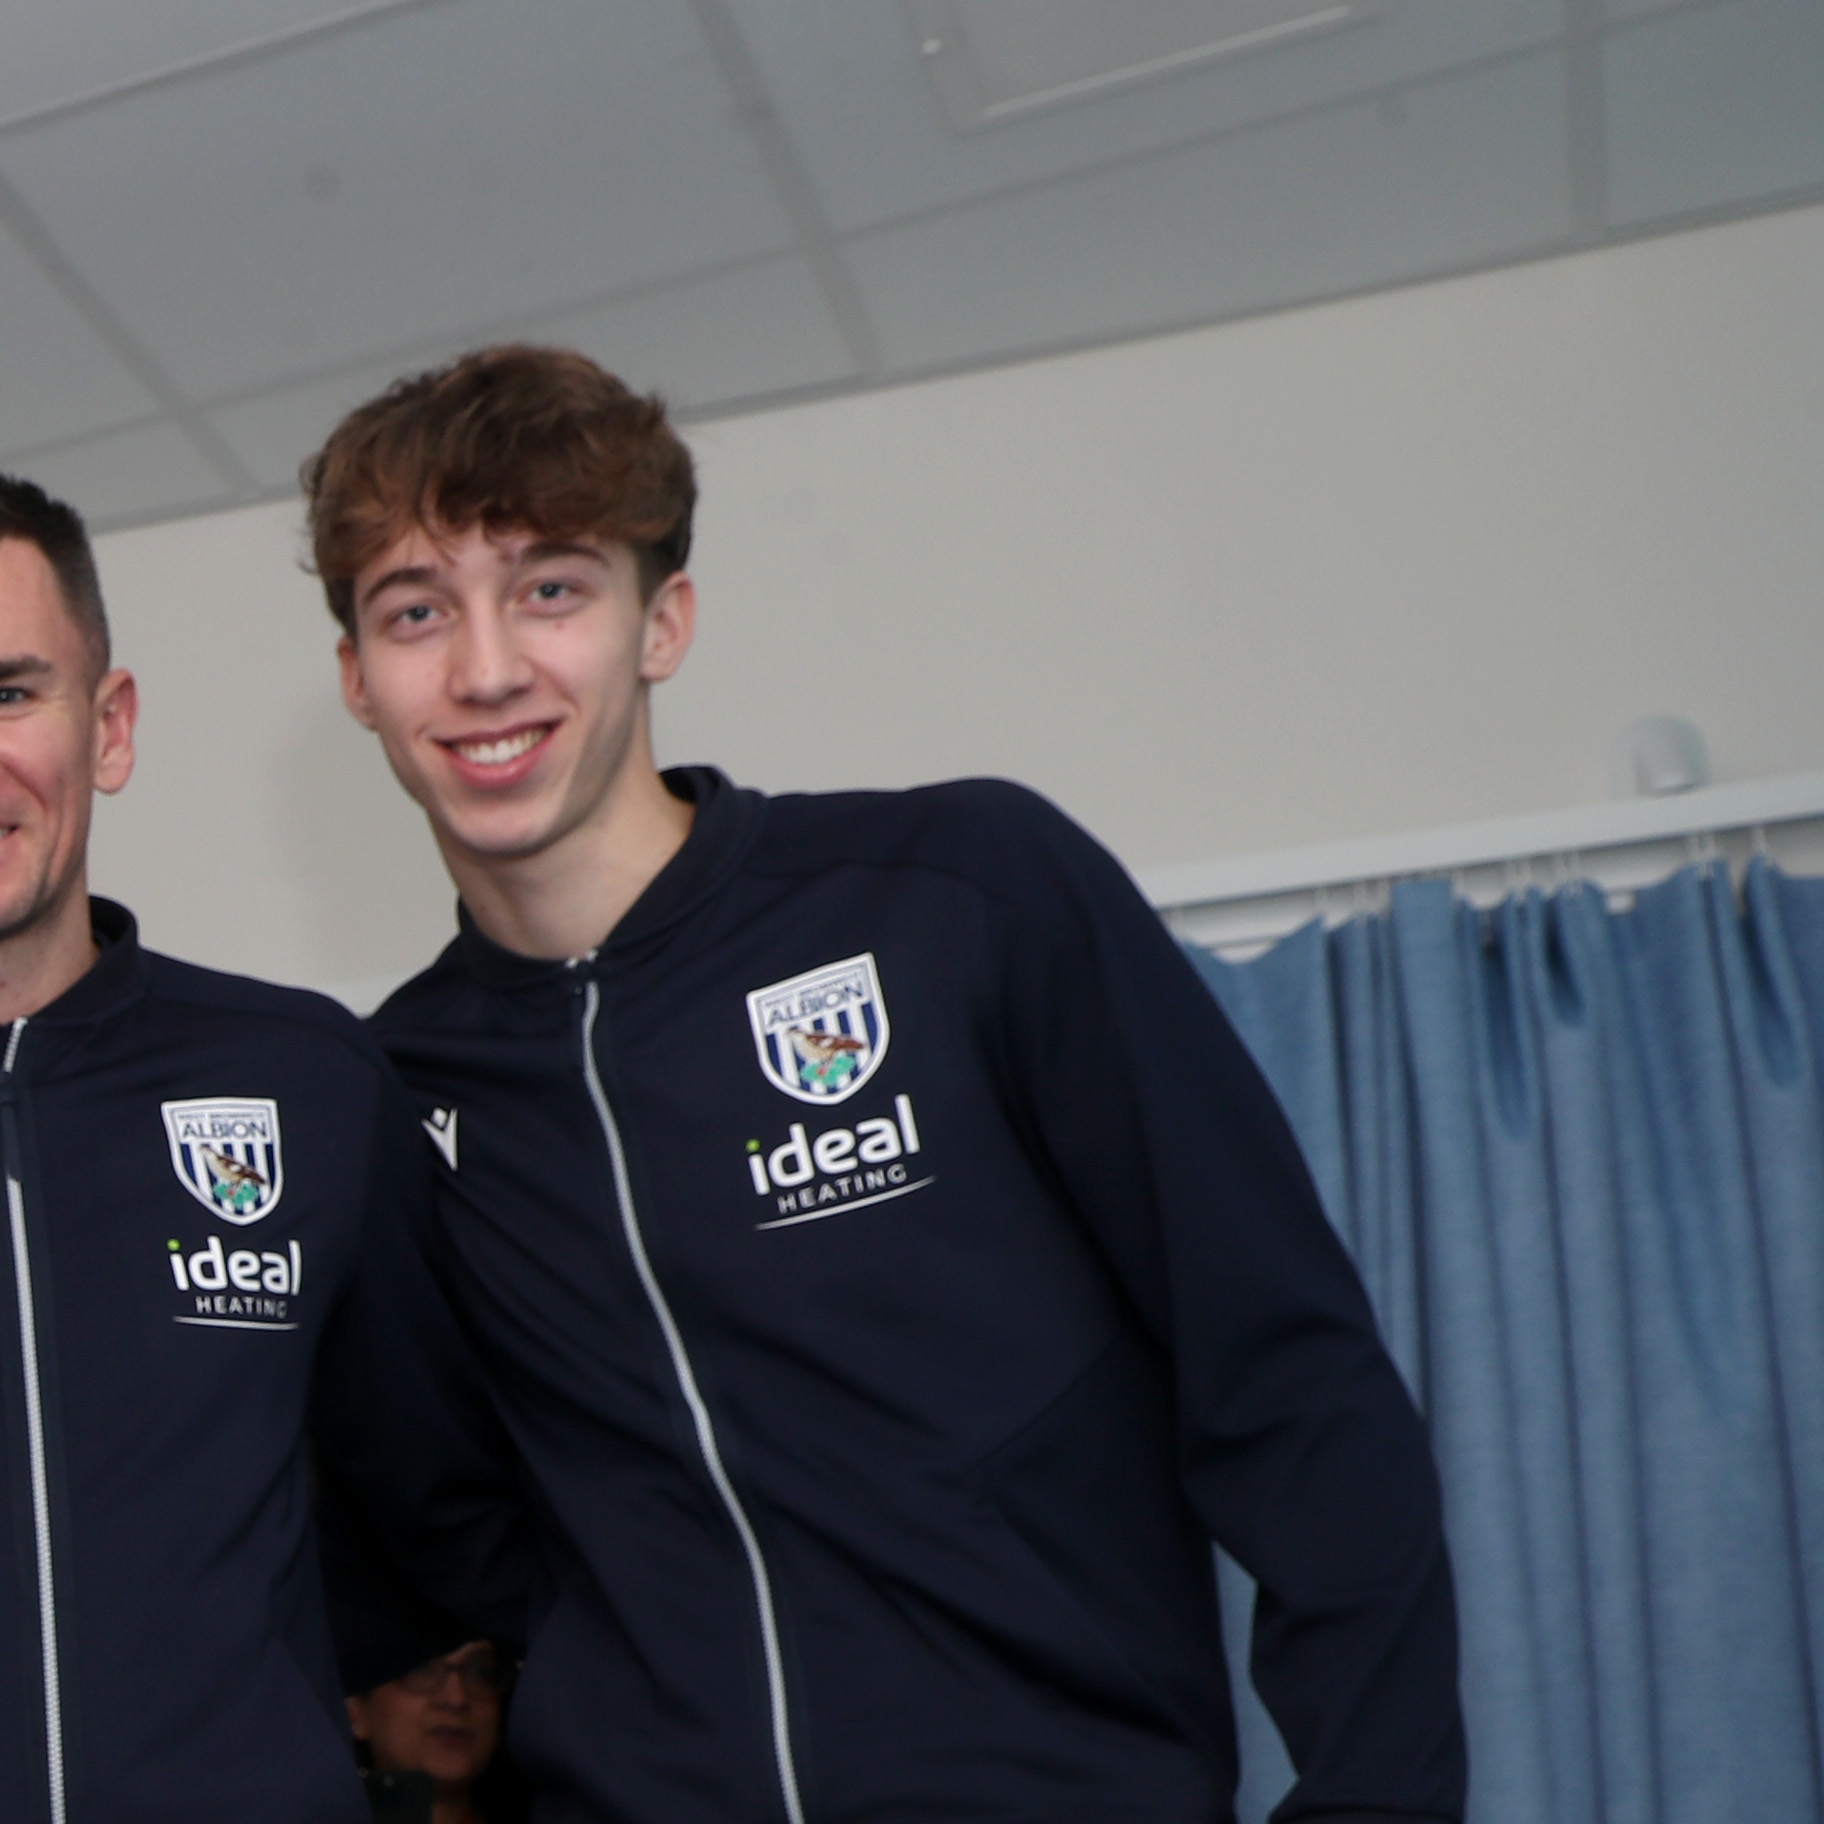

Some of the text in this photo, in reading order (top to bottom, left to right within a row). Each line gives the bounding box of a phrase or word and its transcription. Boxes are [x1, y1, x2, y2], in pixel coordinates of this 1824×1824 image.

[768, 981, 863, 1025] ALBION
[183, 1121, 266, 1139] ALBION
[746, 1093, 920, 1196] ideal
[777, 1163, 908, 1214] HEATING
[166, 1235, 302, 1296] ideal
[195, 1295, 288, 1319] HEATING
